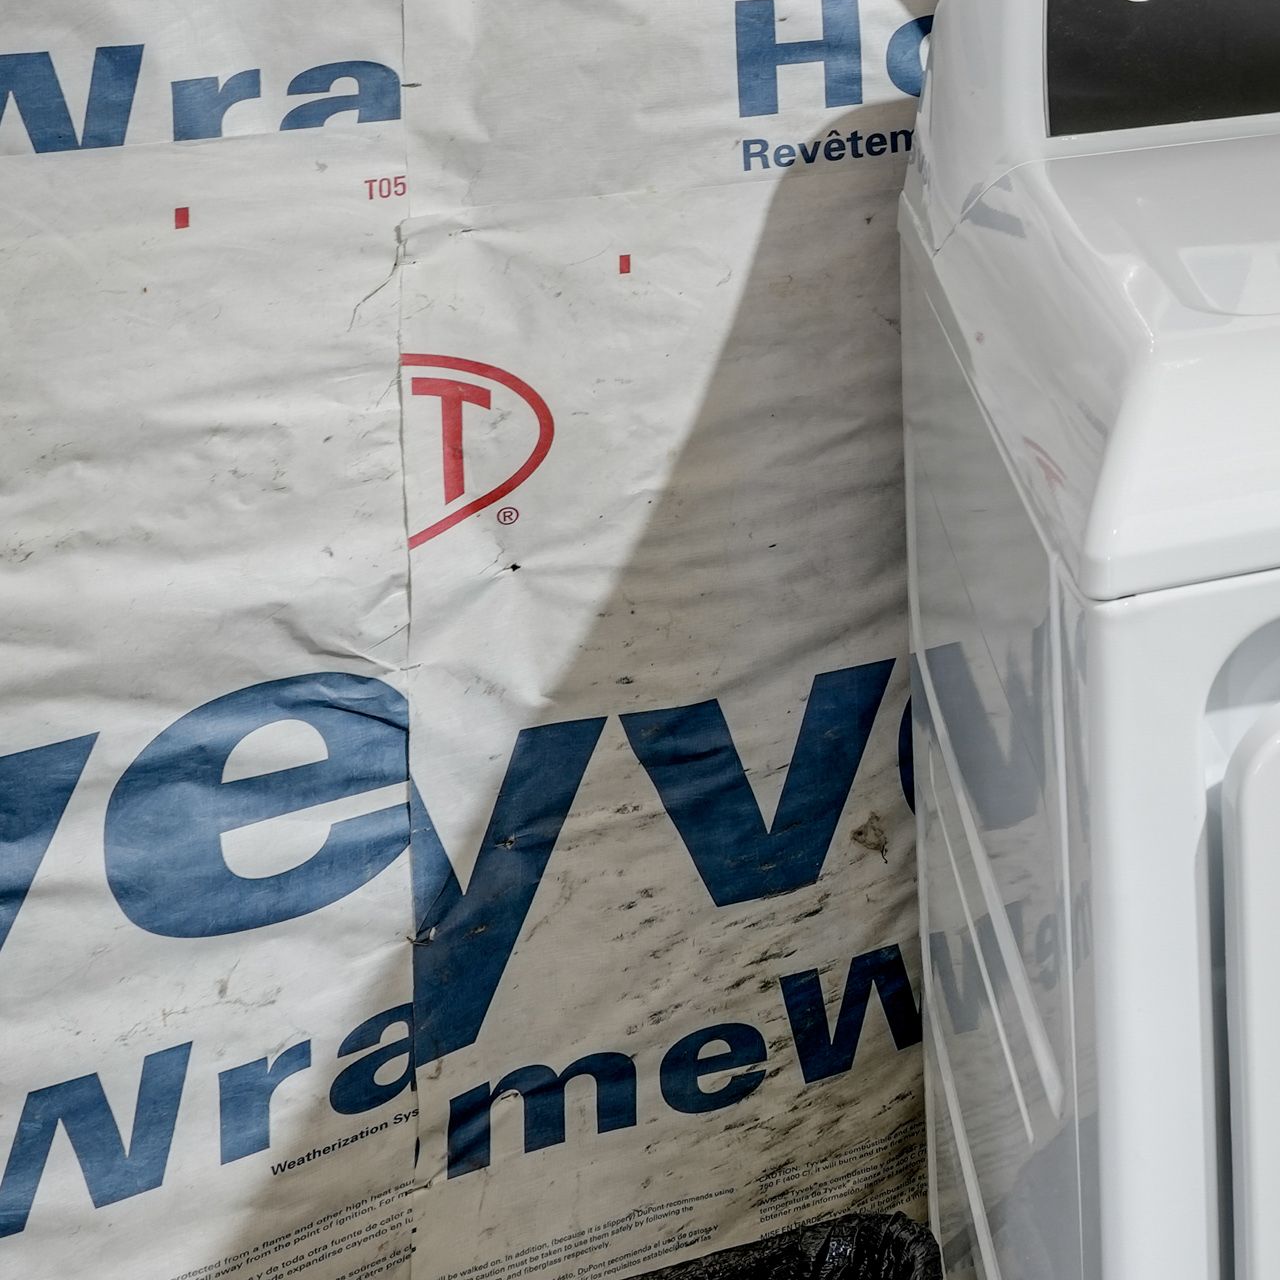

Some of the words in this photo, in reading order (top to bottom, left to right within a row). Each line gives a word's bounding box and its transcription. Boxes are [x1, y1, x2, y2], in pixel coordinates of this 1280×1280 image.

[271, 1120, 388, 1176] Weatherization
[214, 1261, 242, 1278] away
[294, 1227, 320, 1246] point
[336, 1205, 376, 1227] ignition.
[262, 1232, 291, 1249] flame
[316, 1210, 342, 1226] other
[345, 1197, 367, 1214] high
[330, 1229, 362, 1248] fuente
[380, 1210, 403, 1226] calor
[460, 1261, 488, 1277] walked
[514, 1243, 549, 1259] addition,
[666, 1190, 712, 1208] recommends
[714, 1187, 734, 1195] using
[541, 1247, 562, 1259] taken
[611, 1223, 632, 1235] safely
[646, 1208, 680, 1224] following
[287, 1247, 342, 1276] expandirse
[346, 1228, 387, 1250] cayendo
[348, 1256, 386, 1277] sources
[524, 1257, 561, 1275] fiberglass
[563, 1242, 610, 1261] respectively.
[577, 1258, 605, 1275] DuPont
[604, 1257, 640, 1276] requisitos
